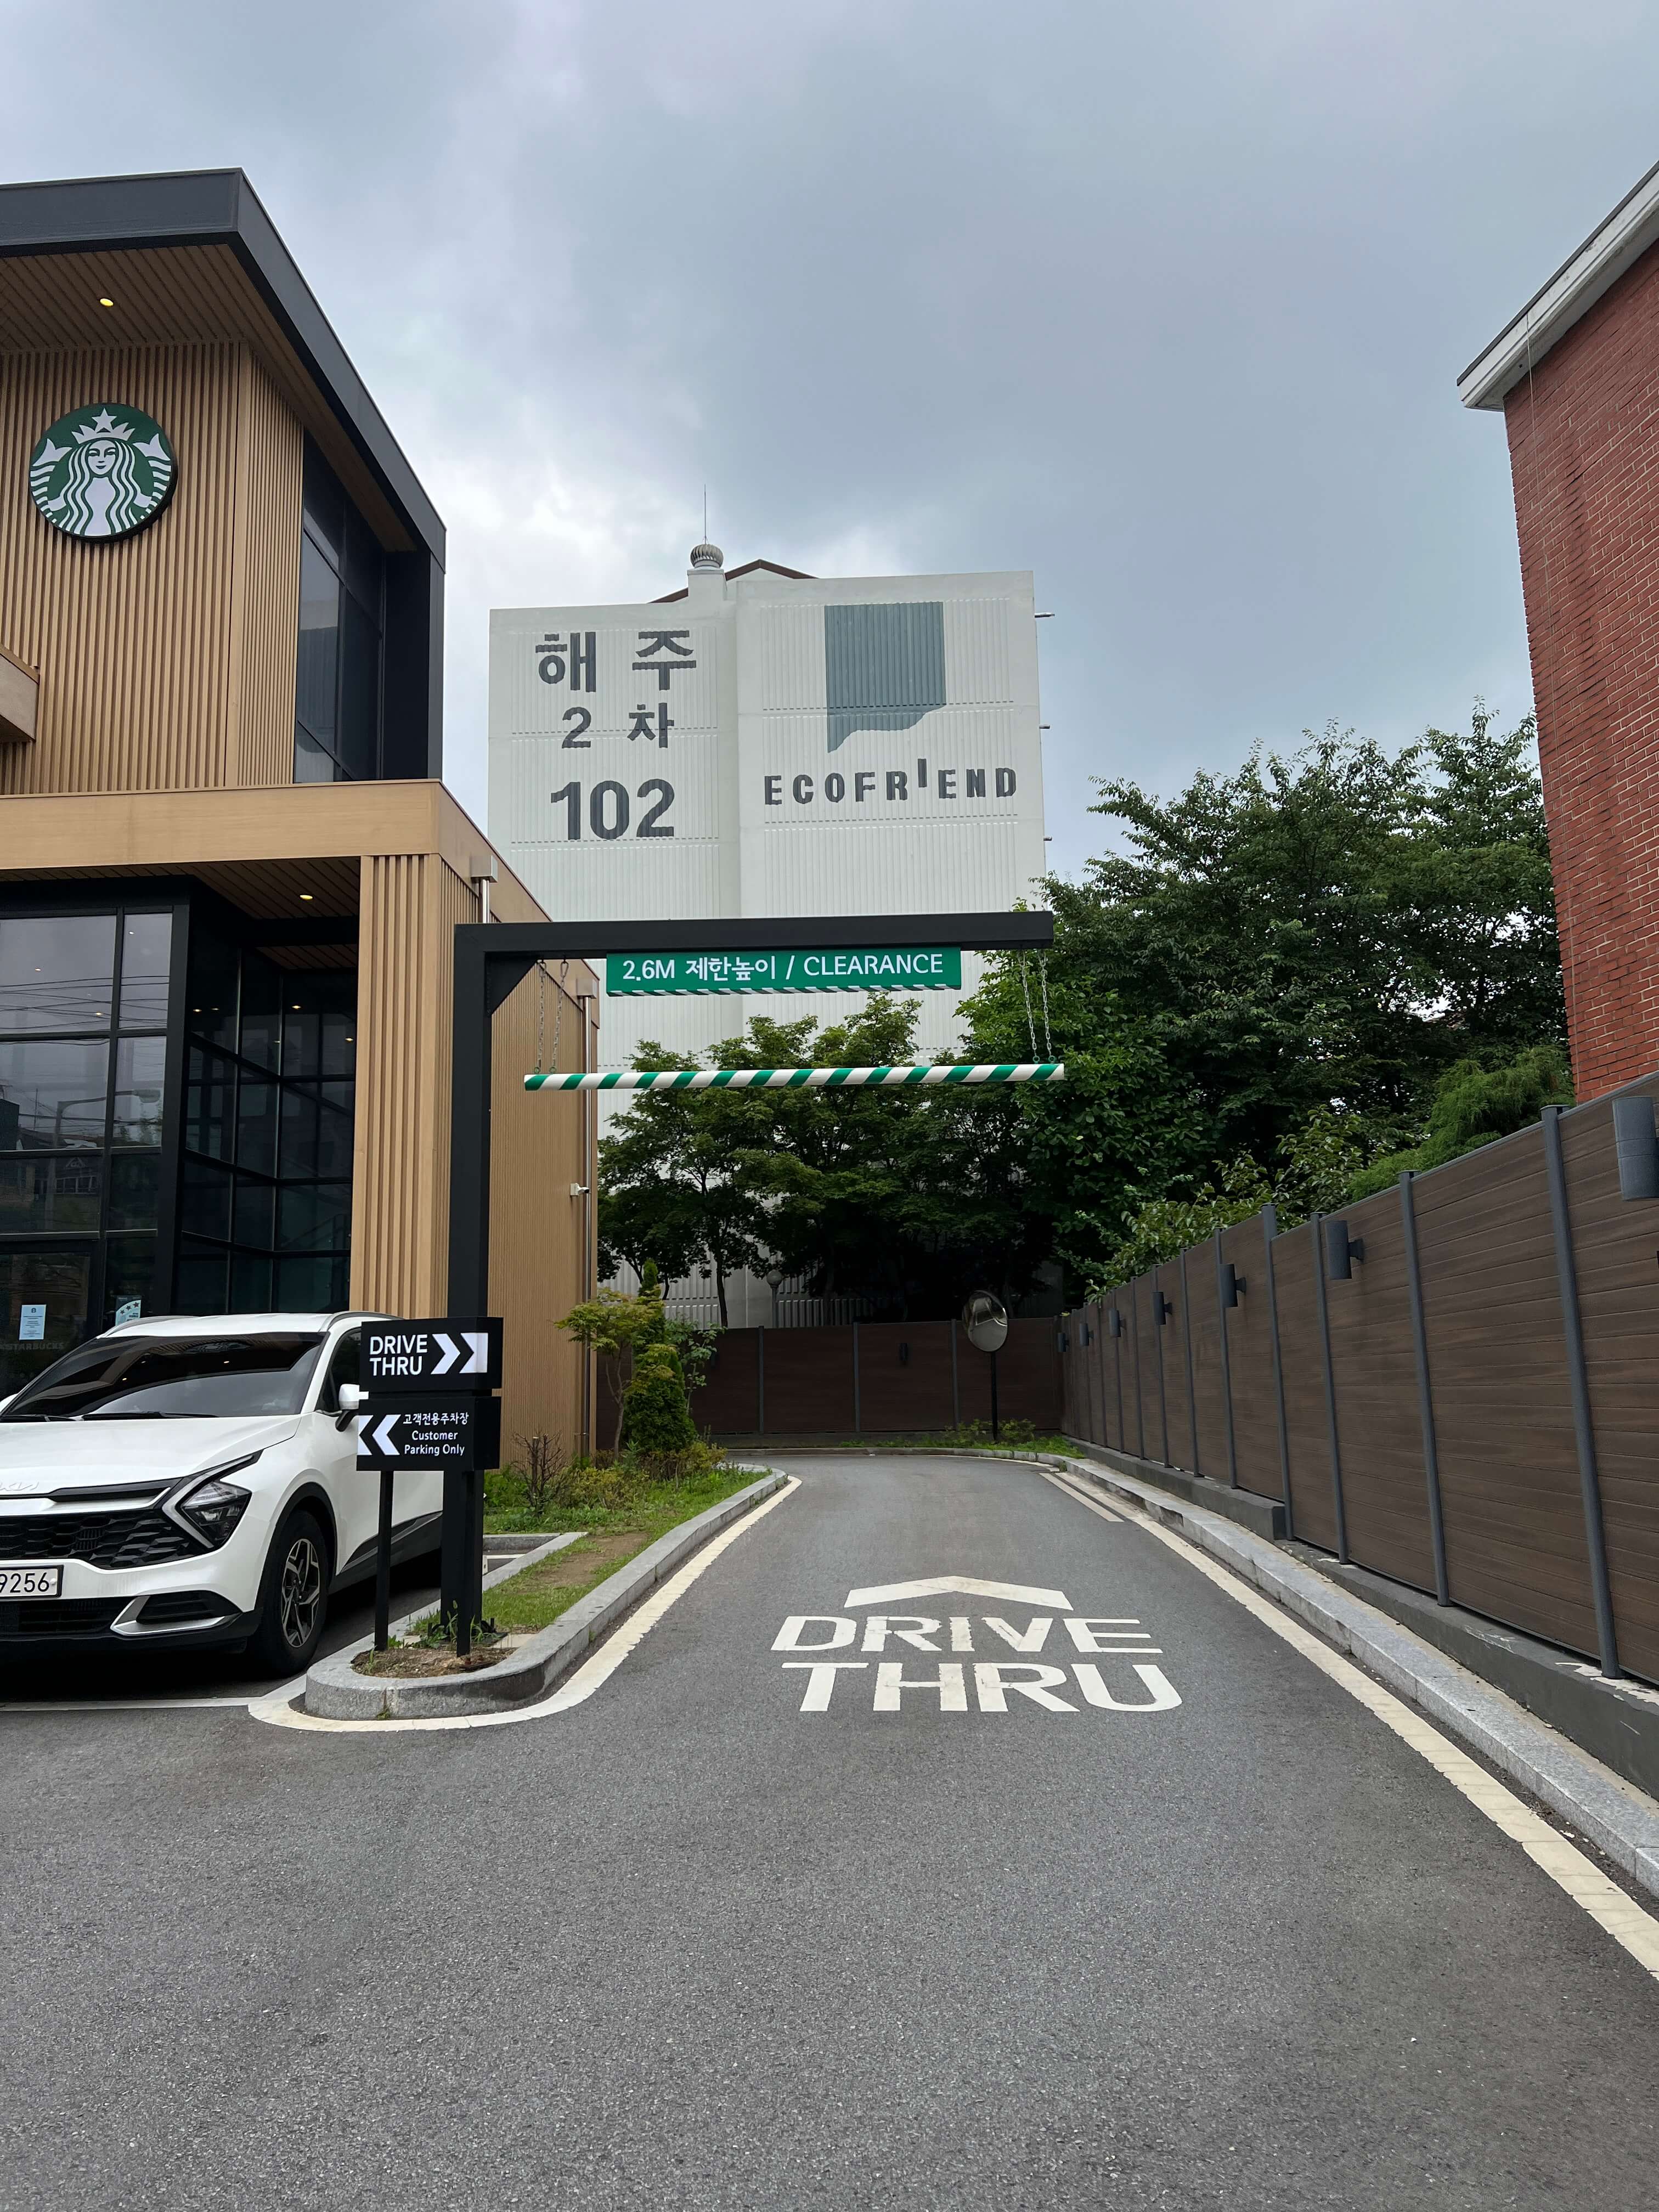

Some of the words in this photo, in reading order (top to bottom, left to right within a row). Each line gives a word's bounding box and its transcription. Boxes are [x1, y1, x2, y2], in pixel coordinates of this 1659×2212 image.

[765, 759, 1017, 805] ECOFRIEND
[550, 778, 675, 840] 102
[623, 959, 675, 981] 2.6M
[685, 955, 775, 981] 제한높이
[804, 953, 943, 976] CLEARANCE
[370, 1334, 428, 1355] DRIVE
[369, 1356, 422, 1376] THRU
[403, 1412, 469, 1425] 고객전용주차장
[411, 1430, 458, 1441] Customer
[404, 1444, 440, 1456] Parking
[442, 1443, 465, 1456] Only
[0, 1572, 49, 1593] 9256
[770, 1616, 1163, 1654] DRIVE
[781, 1662, 1183, 1712] THRU
